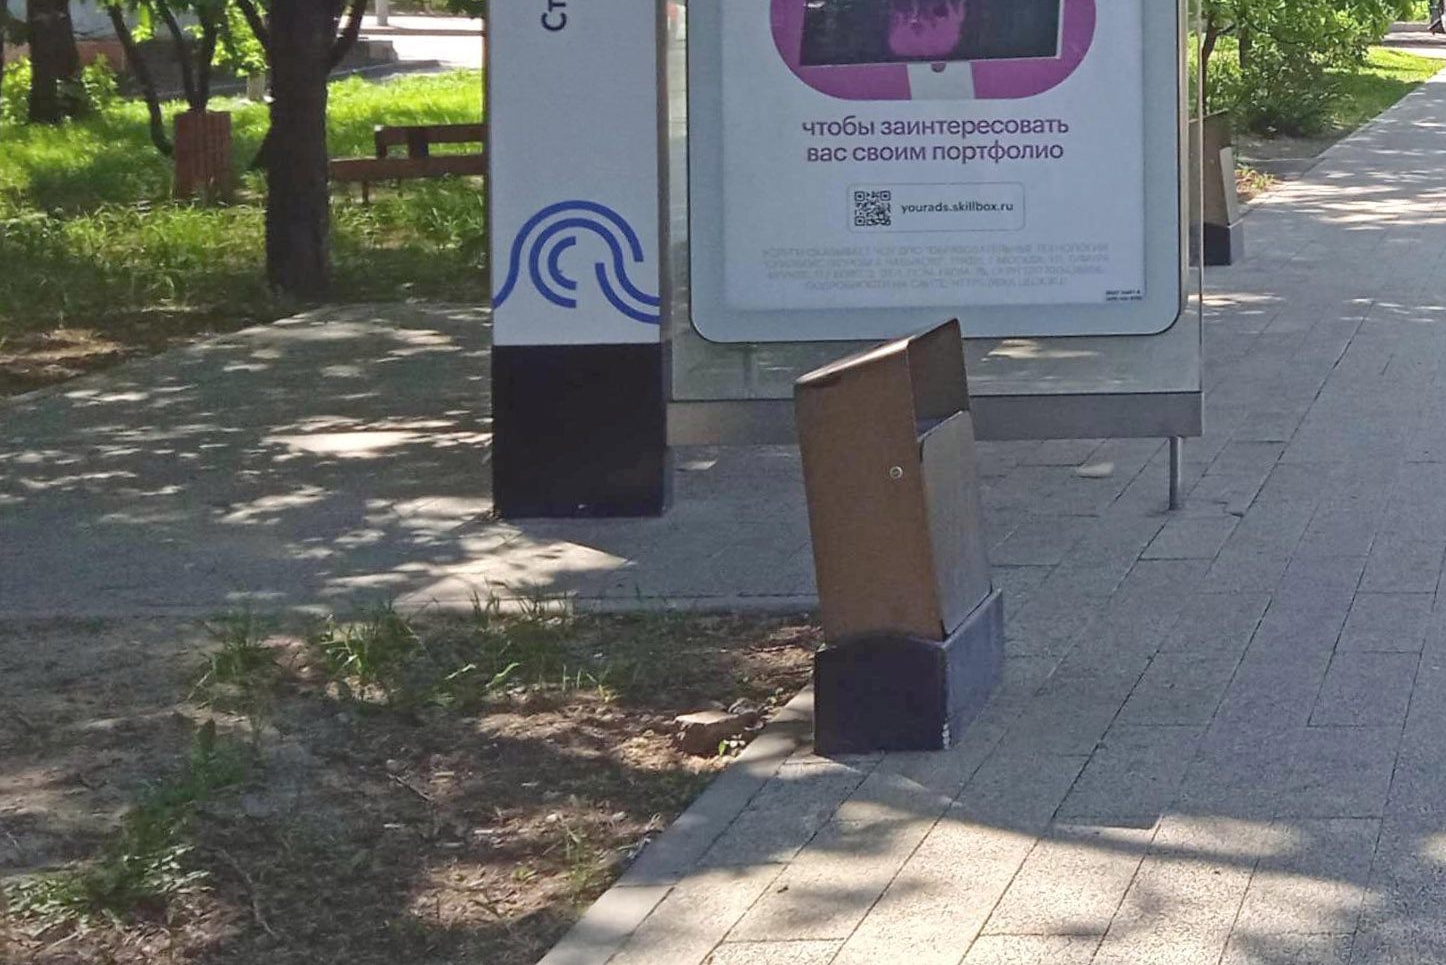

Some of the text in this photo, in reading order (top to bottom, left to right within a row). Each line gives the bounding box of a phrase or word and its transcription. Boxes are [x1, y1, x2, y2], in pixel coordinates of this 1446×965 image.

[802, 115, 1070, 138] чтобы заинтересовать
[806, 140, 1064, 164] вас своим портфолио
[901, 200, 1014, 214] yourads.skillbox.ru
